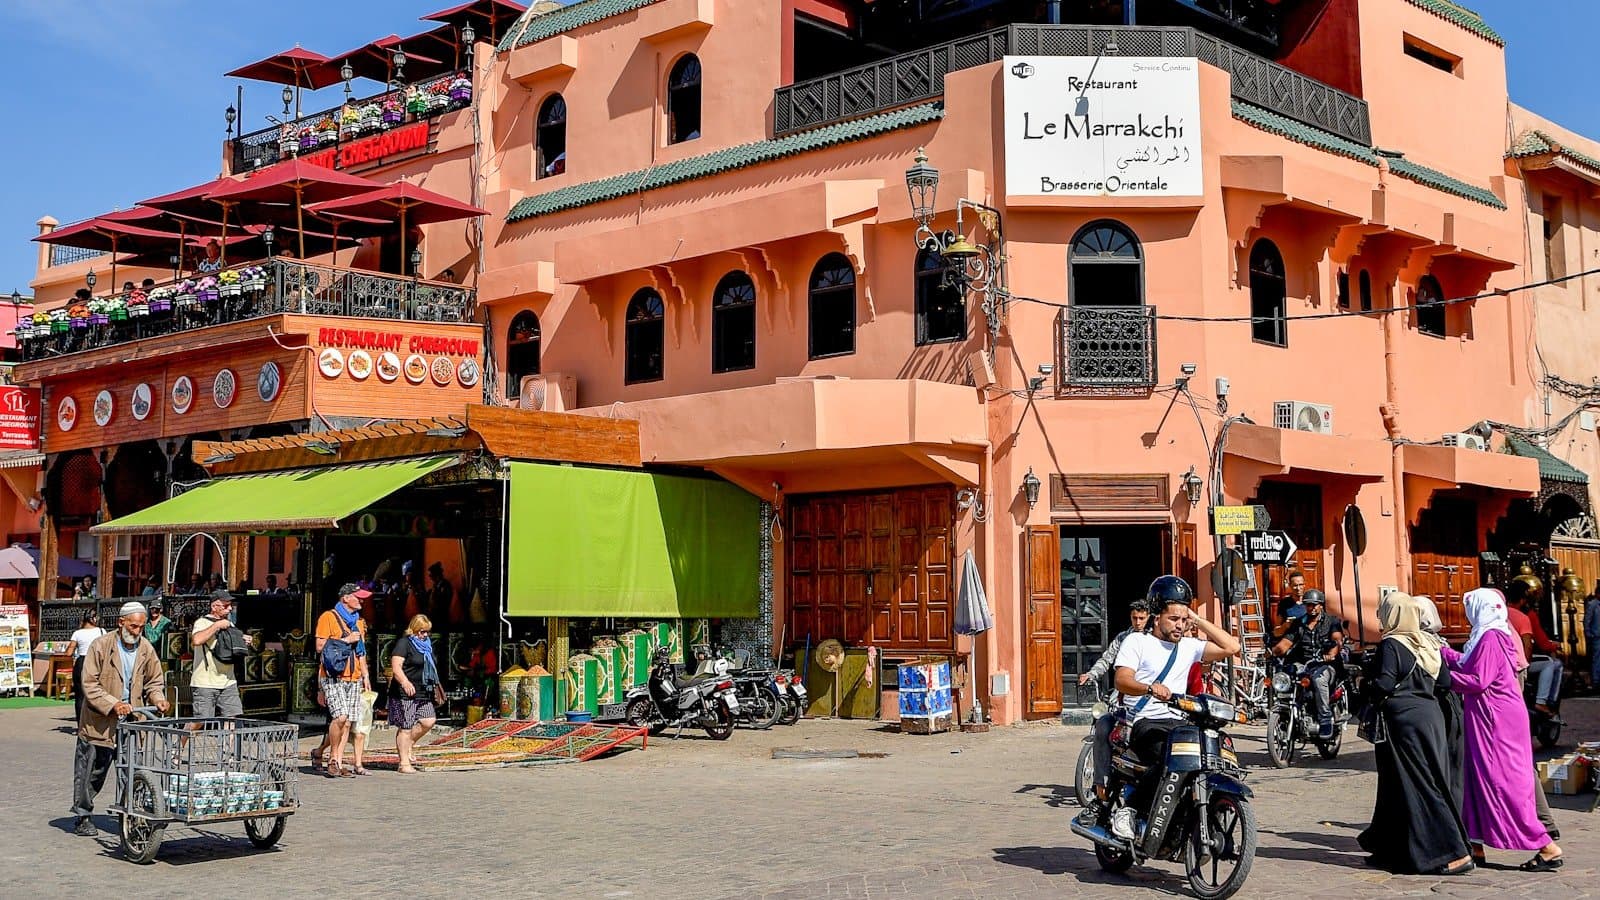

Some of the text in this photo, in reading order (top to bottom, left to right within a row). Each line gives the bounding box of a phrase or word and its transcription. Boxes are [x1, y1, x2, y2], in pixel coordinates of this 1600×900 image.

[1132, 63, 1191, 73] Service Continu
[1068, 76, 1138, 92] Restaurant
[1023, 112, 1184, 140] Le Marrakchi
[340, 122, 430, 168] CHEGROUNI
[1116, 145, 1190, 174] المراكشي
[1040, 175, 1168, 193] Brasserie Orientale
[318, 327, 479, 357] RESTAURANT CHEGROUNI
[1150, 772, 1179, 838] DOOKER
